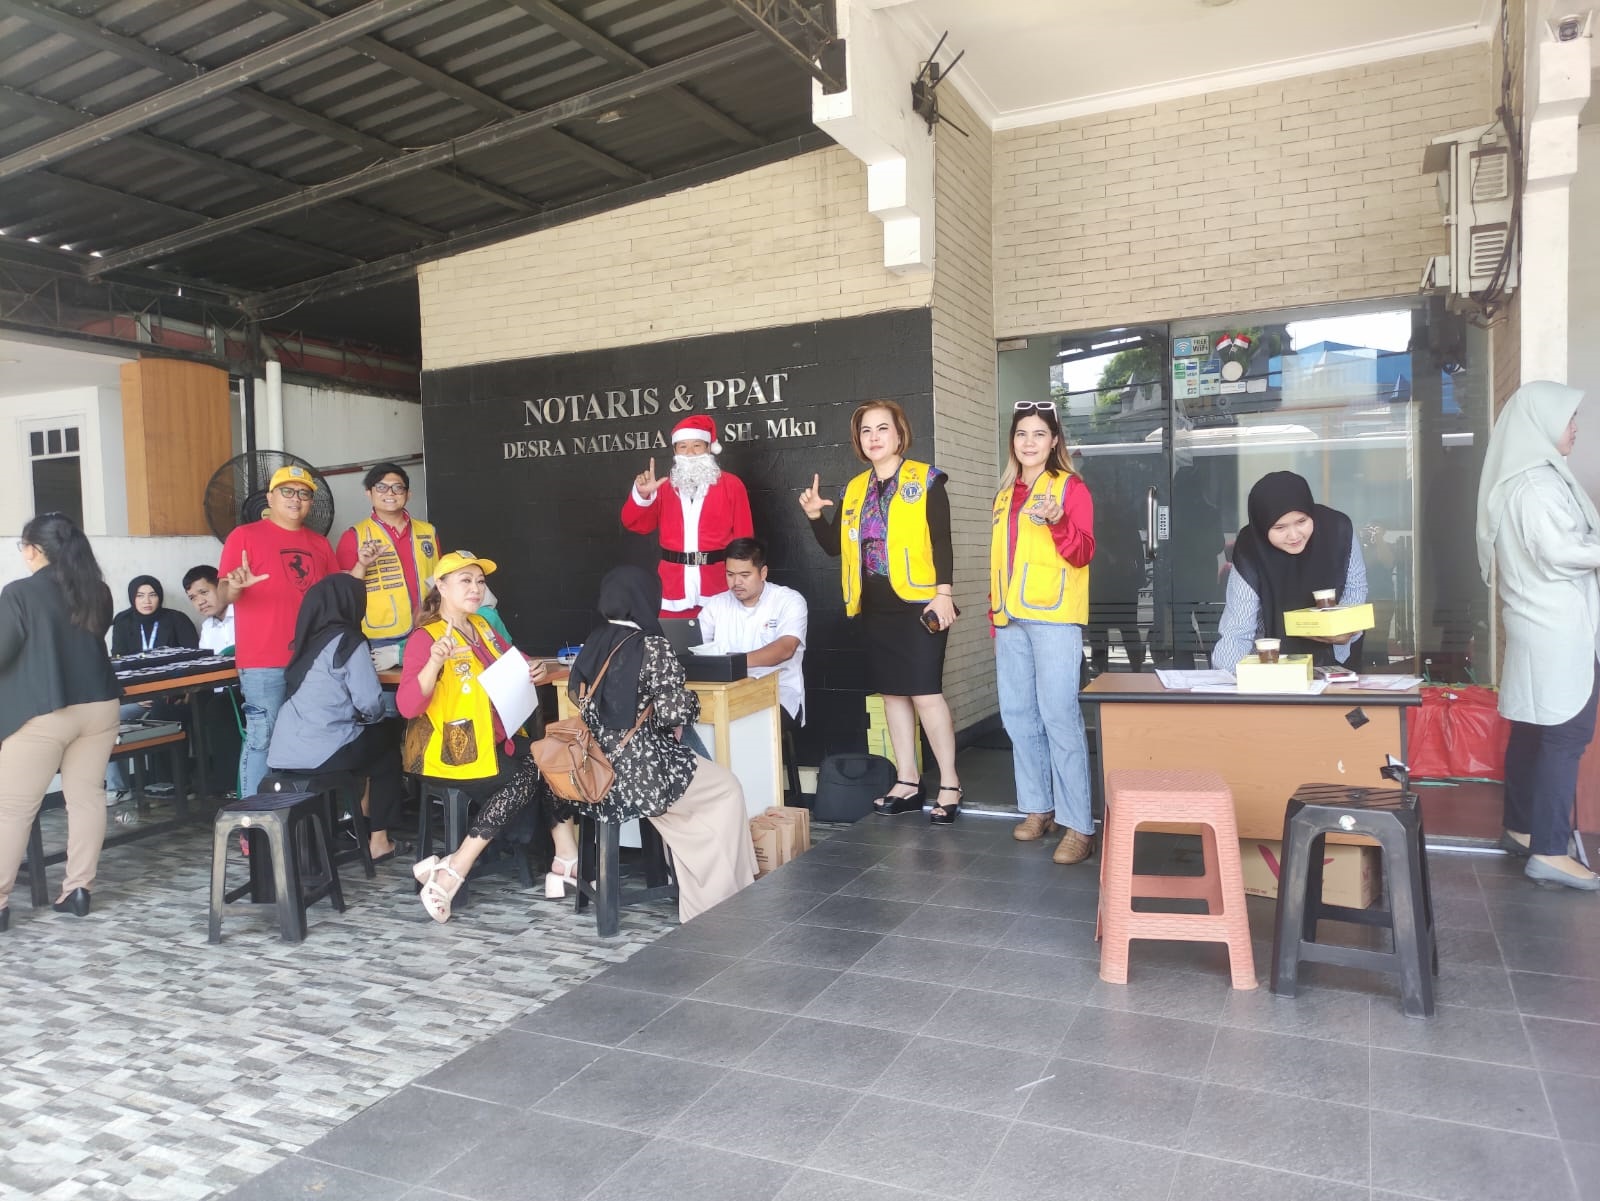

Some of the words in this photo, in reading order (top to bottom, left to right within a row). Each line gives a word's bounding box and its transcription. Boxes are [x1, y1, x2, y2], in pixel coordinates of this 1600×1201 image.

[523, 387, 660, 426] NOTARIS
[669, 384, 694, 413] &
[704, 373, 788, 410] PPAT
[503, 439, 567, 460] DESRA
[572, 429, 668, 455] NATASHA
[724, 422, 761, 443] SH.
[767, 416, 817, 439] Mkn
